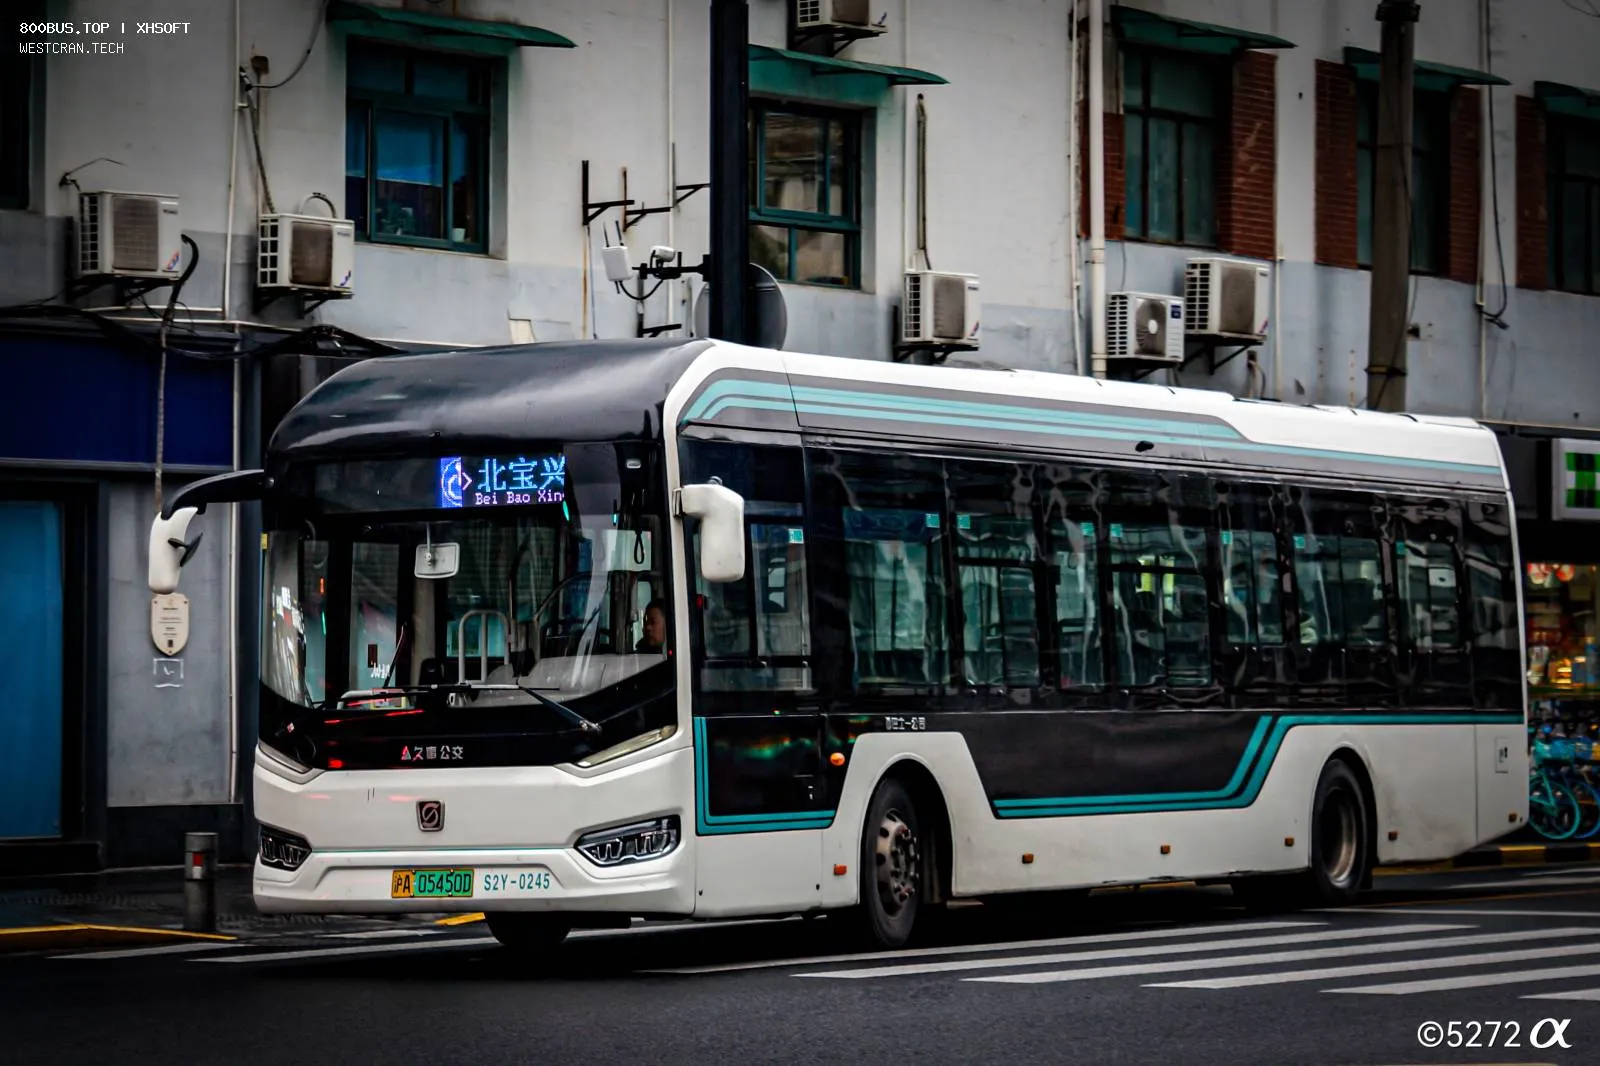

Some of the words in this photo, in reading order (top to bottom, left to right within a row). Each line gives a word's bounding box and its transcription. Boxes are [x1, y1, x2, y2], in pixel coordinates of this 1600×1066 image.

[477, 455, 565, 492] 北宝兴
[475, 492, 498, 505] Bei
[506, 491, 531, 504] Bao
[483, 872, 550, 891] S2Y-0245
